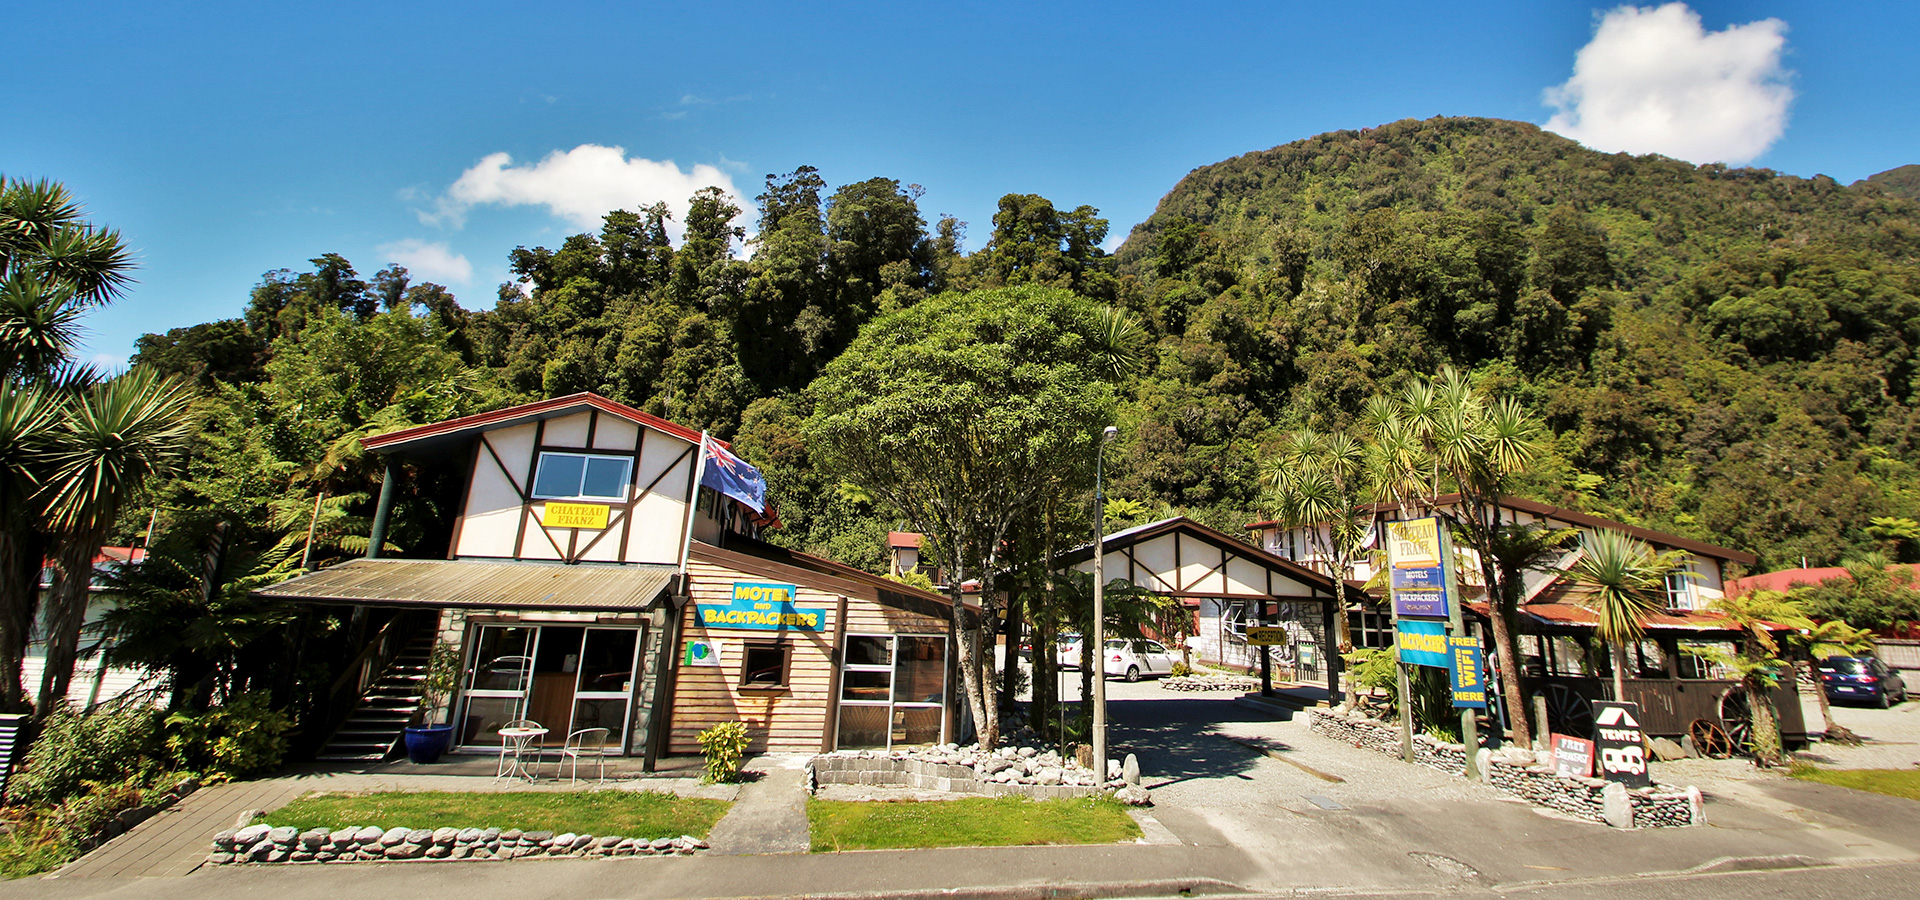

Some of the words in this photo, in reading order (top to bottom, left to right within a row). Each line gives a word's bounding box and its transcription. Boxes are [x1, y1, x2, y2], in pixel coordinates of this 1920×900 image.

[551, 506, 603, 516] CHATEAU
[558, 515, 594, 525] FRANZ
[1400, 541, 1431, 556] FRANZ
[1405, 570, 1428, 579] MOTELS
[734, 586, 792, 602] MOTEL
[1399, 593, 1440, 602] BACKPACKERS
[753, 602, 772, 610] AND
[703, 609, 818, 627] BACKPACKERS
[1259, 630, 1284, 642] RECEPTION
[1398, 631, 1447, 654] BACKPACKERS
[1448, 637, 1479, 647] FREE
[1455, 648, 1465, 688] UNLIMITED
[1461, 649, 1477, 687] WIFI
[1453, 691, 1486, 702] HERE
[1598, 728, 1642, 743] TENTS
[1561, 738, 1586, 752] FREE
